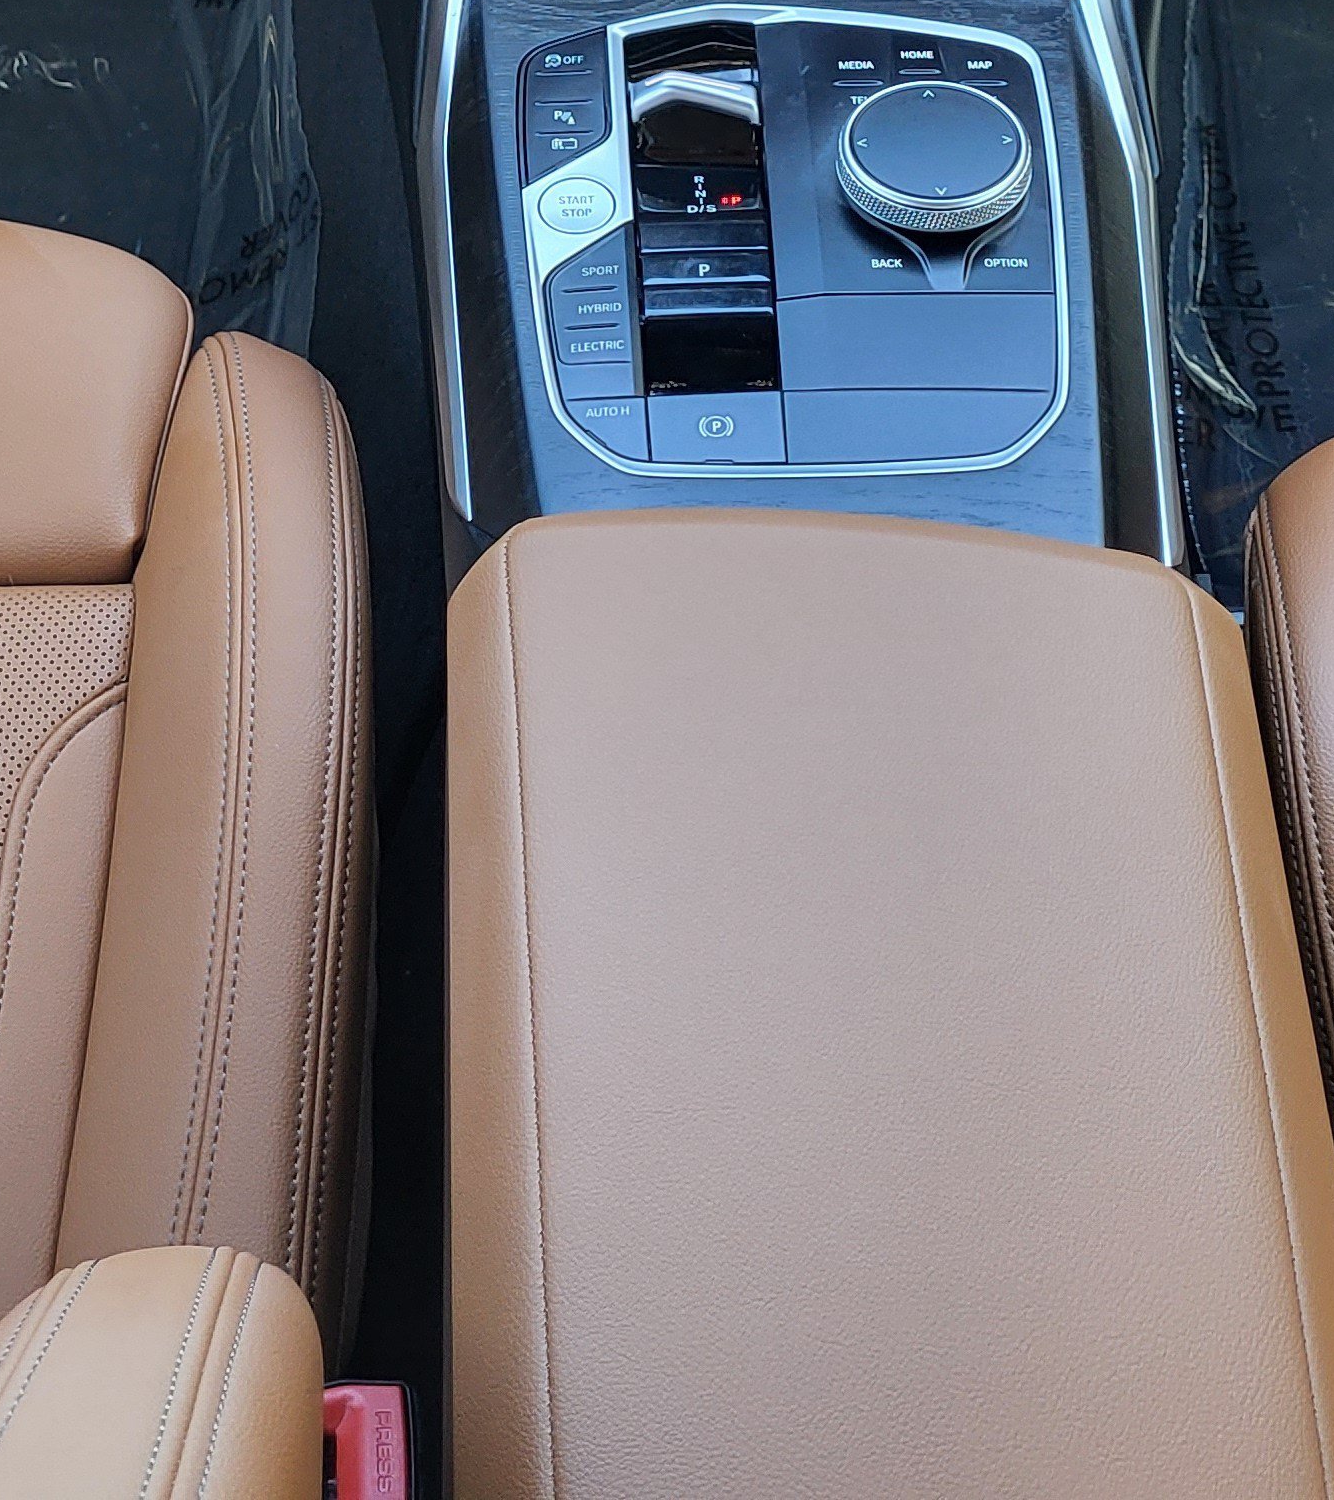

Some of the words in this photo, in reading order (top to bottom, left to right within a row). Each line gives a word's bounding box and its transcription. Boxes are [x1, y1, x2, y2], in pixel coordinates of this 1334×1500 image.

[562, 55, 584, 65] OFF
[900, 50, 934, 60] HOME
[838, 59, 875, 70] MEDIA
[967, 60, 993, 70] MAP
[693, 175, 705, 184] R
[694, 189, 707, 198] N
[557, 194, 595, 206] START
[561, 207, 592, 218] STOP
[686, 204, 717, 214] D/S
[870, 258, 903, 269] BACK
[983, 257, 1029, 269] OPTION
[581, 264, 620, 277] SPORT
[697, 263, 711, 278] P
[577, 302, 622, 314] HYBRID
[570, 338, 625, 353] ELECTRIC
[585, 406, 615, 418] AUTO
[619, 405, 630, 417] H
[374, 1410, 394, 1494] PRESS
